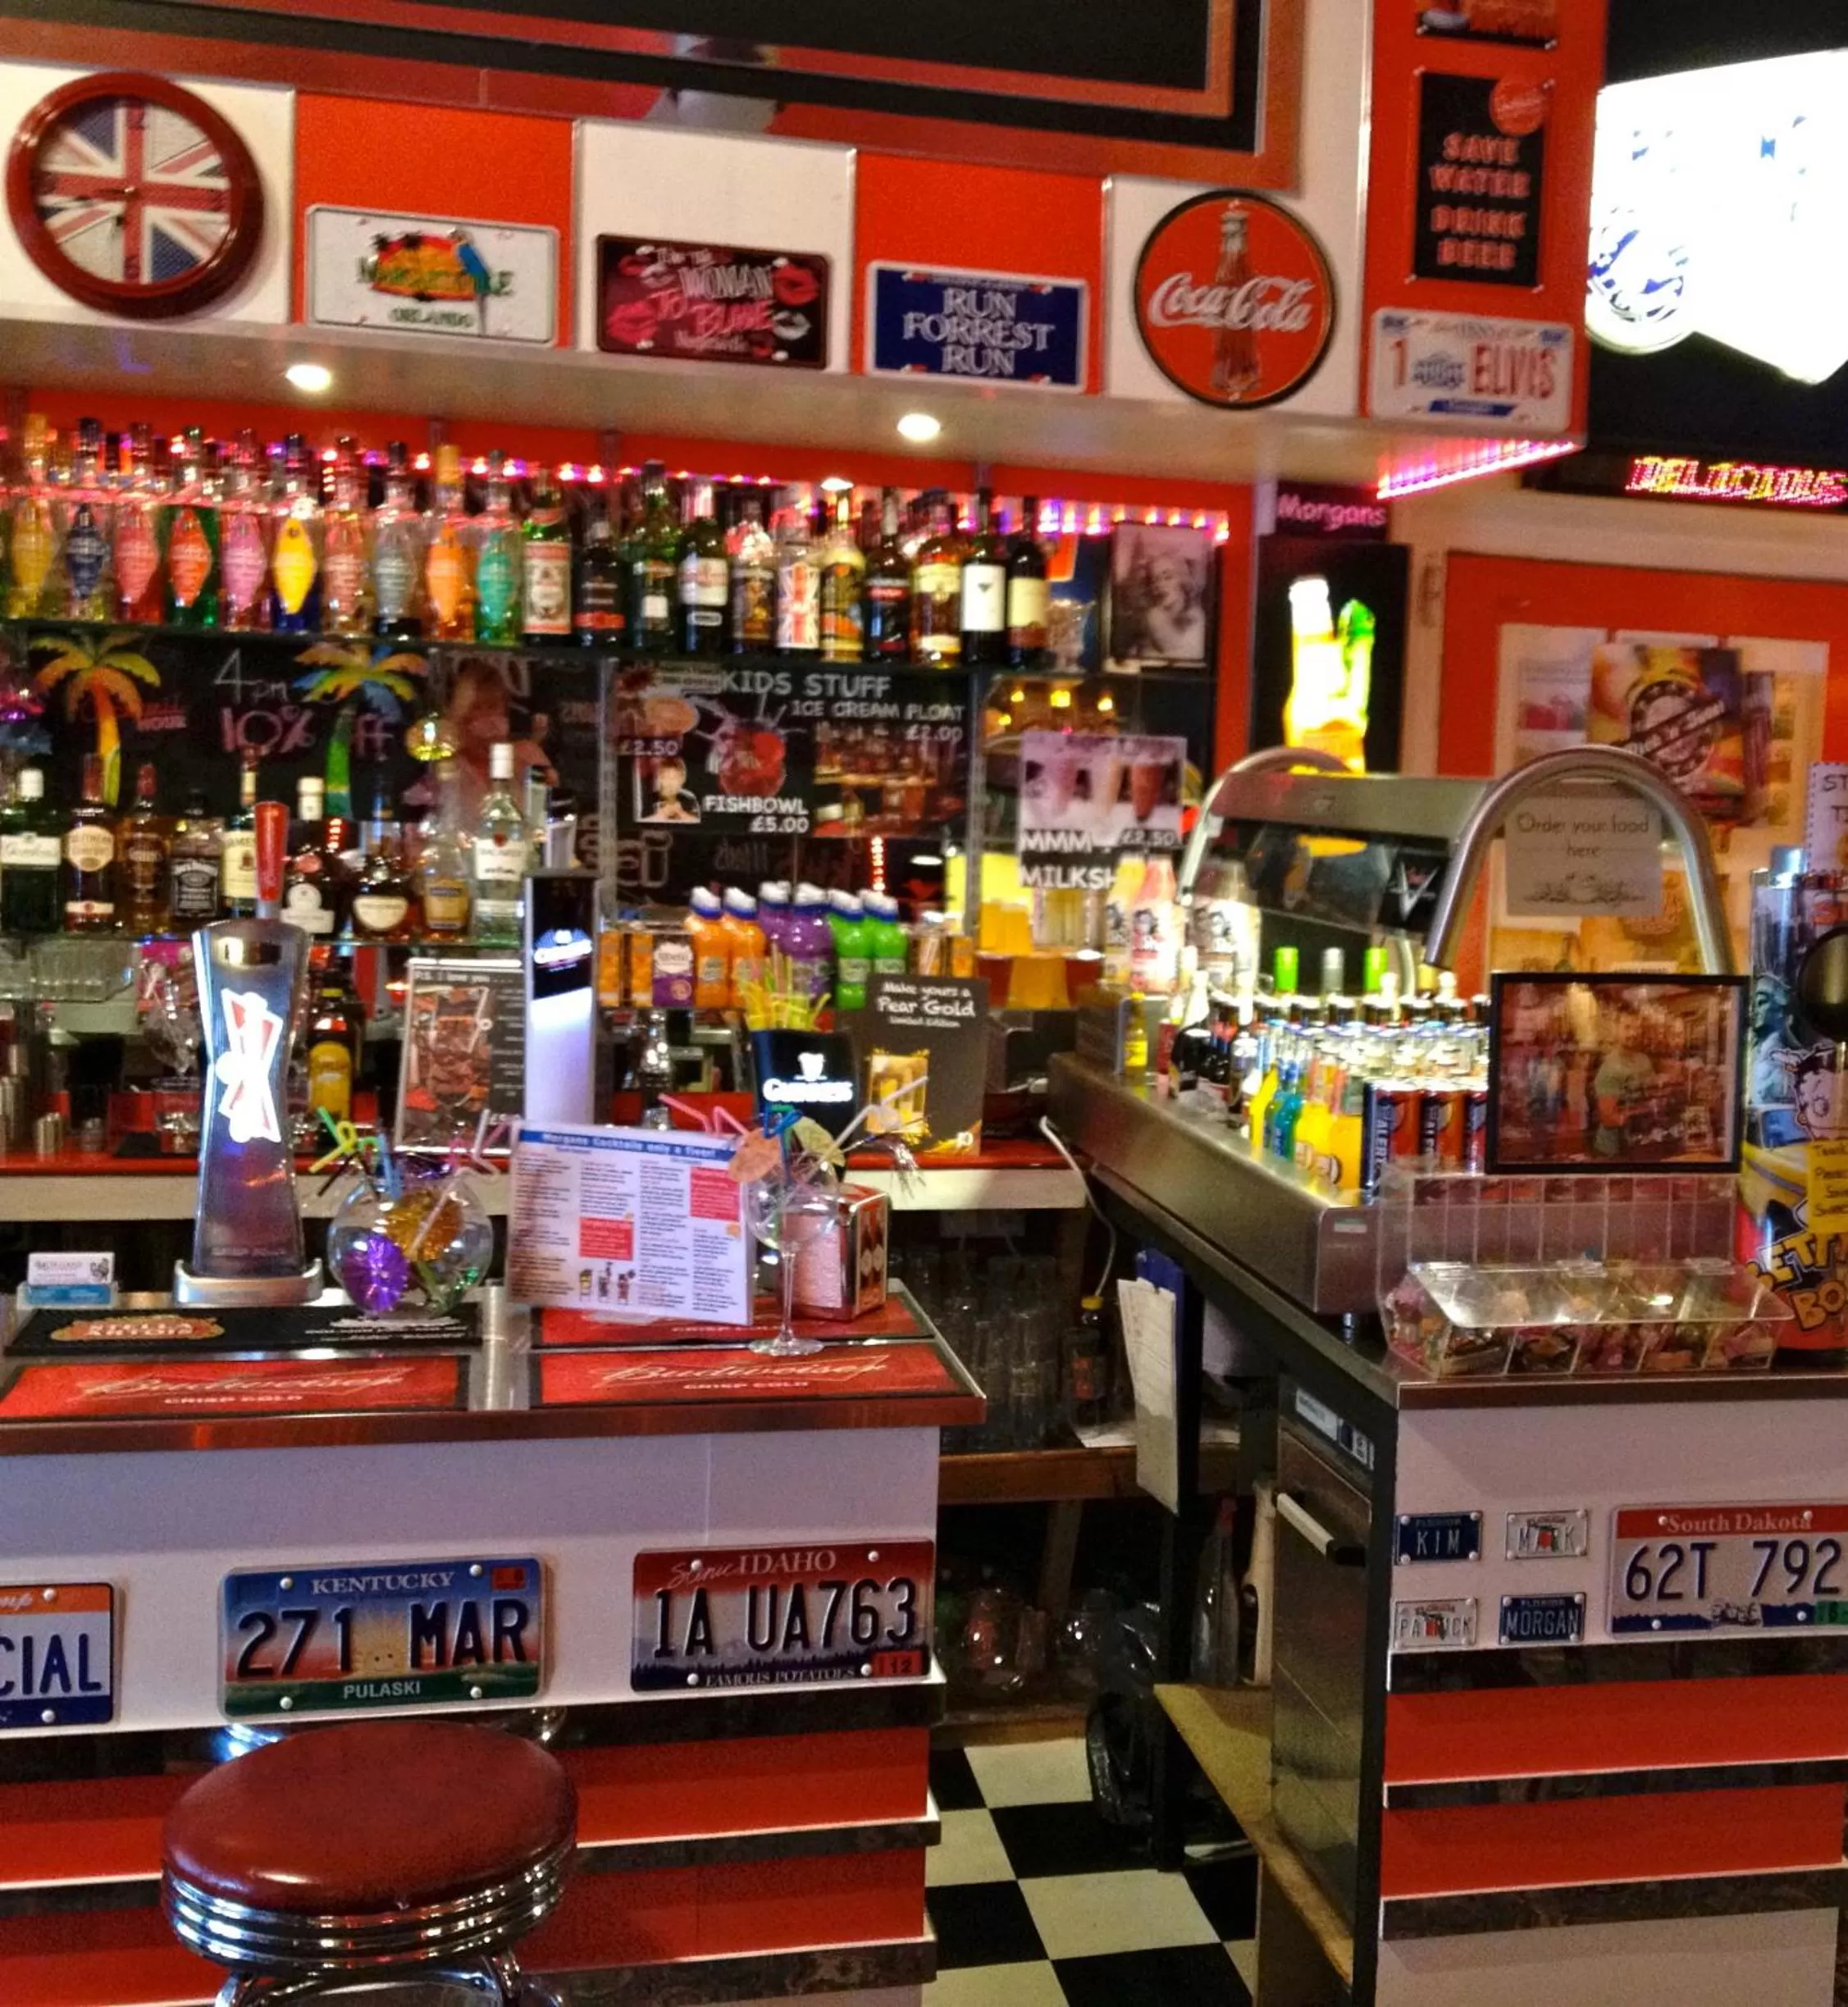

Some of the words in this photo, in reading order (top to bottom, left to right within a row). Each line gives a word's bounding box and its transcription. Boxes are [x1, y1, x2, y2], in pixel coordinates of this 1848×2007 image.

[1443, 132, 1519, 163] SAVE
[1429, 163, 1531, 198] WATER
[1430, 205, 1526, 239] DRINK
[1437, 237, 1516, 270] BEER
[942, 287, 1017, 319] RUN
[903, 312, 1055, 352] FORREST
[942, 345, 1015, 376] RUN
[1471, 342, 1556, 399] ELVIS
[1278, 493, 1386, 531] Morgans
[721, 671, 792, 696] KIDS
[802, 672, 891, 699] STUFF
[792, 700, 824, 716] ICE
[833, 701, 899, 719] CREAM
[905, 703, 965, 722] FLOAT
[702, 796, 809, 815] FISHBOWL
[751, 816, 809, 833] £5.00
[1517, 812, 1565, 834] Order
[1612, 813, 1650, 833] food
[883, 981, 917, 995] Make
[921, 984, 958, 1001] yours
[961, 988, 971, 997] a
[877, 996, 918, 1013] Pear
[924, 998, 976, 1017] Gold
[602, 1363, 887, 1381] Budweiser
[1668, 1513, 1731, 1533] South
[1736, 1509, 1812, 1530] Dakota
[1417, 1530, 1461, 1556] KIM
[1519, 1524, 1574, 1553] MK
[739, 1550, 837, 1576] IDAHO
[1626, 1542, 1717, 1601] 62T
[1751, 1538, 1841, 1597] 792
[311, 1571, 456, 1595] KENTUCKY
[746, 1576, 917, 1653] UA763
[1506, 1609, 1579, 1635] MORGAN
[235, 1605, 354, 1680] 271
[409, 1598, 532, 1670] MAR
[343, 1681, 421, 1699] PULASKI
[705, 1673, 770, 1687] FAMOUS
[774, 1669, 855, 1684] POTATOES
